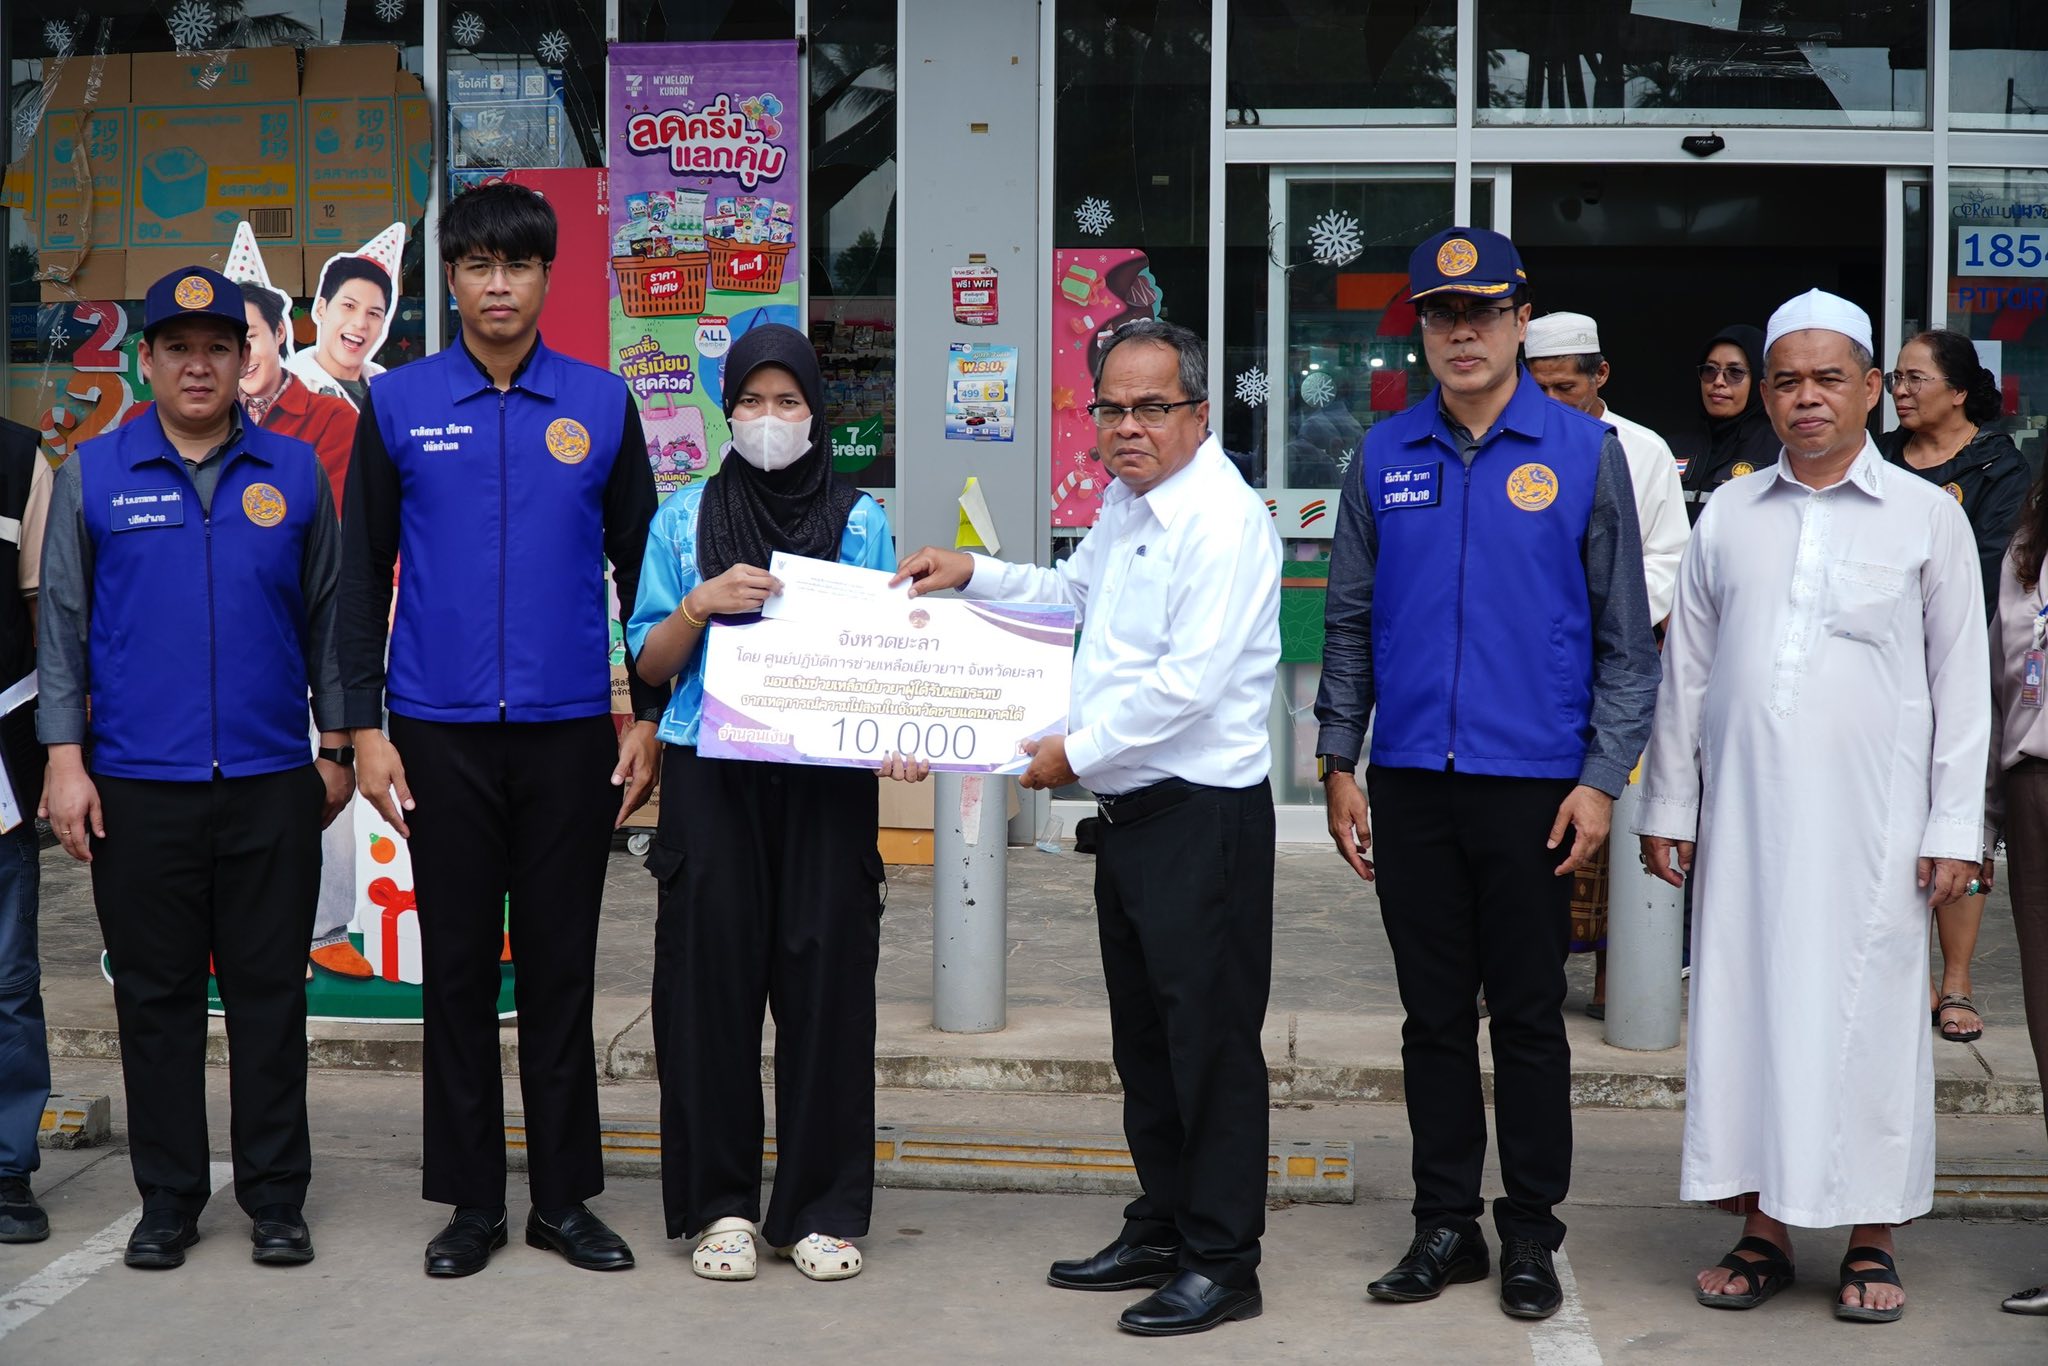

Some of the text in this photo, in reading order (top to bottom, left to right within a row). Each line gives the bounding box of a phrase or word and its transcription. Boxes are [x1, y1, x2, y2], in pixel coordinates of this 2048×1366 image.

[653, 75, 694, 85] MY MELODY
[659, 87, 688, 96] KUROMI
[632, 99, 743, 147] ลดครึ่ง
[675, 135, 782, 184] แลกคุ้ม
[323, 204, 336, 218] 12
[1965, 233, 2048, 268] 185
[650, 271, 676, 282] ราคา
[973, 279, 993, 288] WiFi
[650, 282, 679, 296] พิเศษ
[699, 329, 727, 341] ALL
[620, 336, 659, 359] แลกซื้อ
[623, 355, 688, 378] พรีเมียม
[635, 374, 692, 396] สุดคิวต์
[961, 389, 980, 398] 499
[846, 426, 860, 445] 7
[1384, 487, 1430, 504] นายอำเภอ
[736, 645, 761, 663] โดย
[967, 661, 1044, 679] จังหวัดยะลา
[718, 722, 790, 745] จำนวนเงิน
